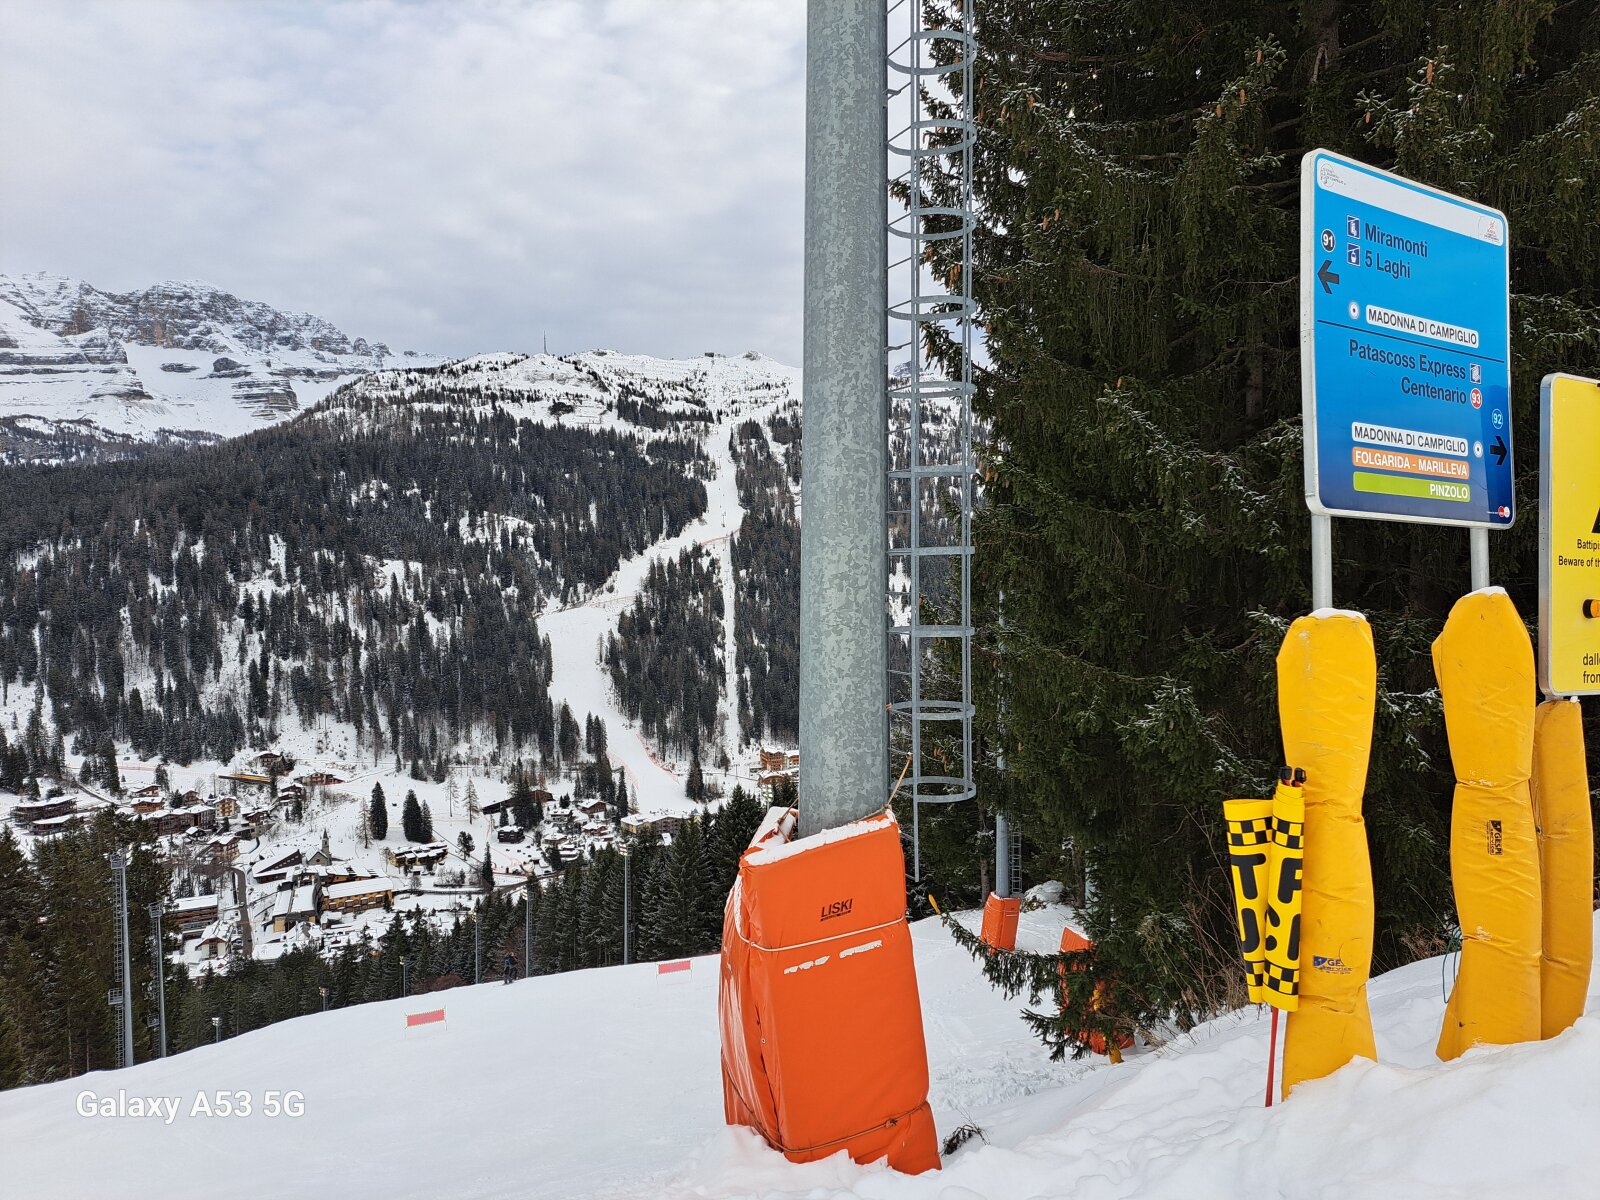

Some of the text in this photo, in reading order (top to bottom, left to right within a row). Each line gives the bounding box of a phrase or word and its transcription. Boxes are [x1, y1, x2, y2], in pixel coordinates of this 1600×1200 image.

[1321, 232, 1335, 249] 91
[1365, 223, 1428, 258] Miramonti
[1364, 250, 1411, 279] 5 Laghi
[1368, 308, 1477, 345] MADONNA DI CAMPIGLIO
[1349, 339, 1466, 379] Patascoss Express
[1401, 376, 1481, 405] Centenario 93
[1492, 413, 1503, 425] 92
[1354, 425, 1466, 454] MADONNA DI CAMPIGLIO
[1355, 450, 1411, 470] FOLGARIDA
[1418, 460, 1468, 476] MARILLEVA
[1429, 483, 1468, 499] PINZOLO
[1558, 555, 1585, 567] Beware
[1586, 557, 1594, 567] of
[1583, 652, 1600, 666] dall
[820, 898, 853, 918] LISKI
